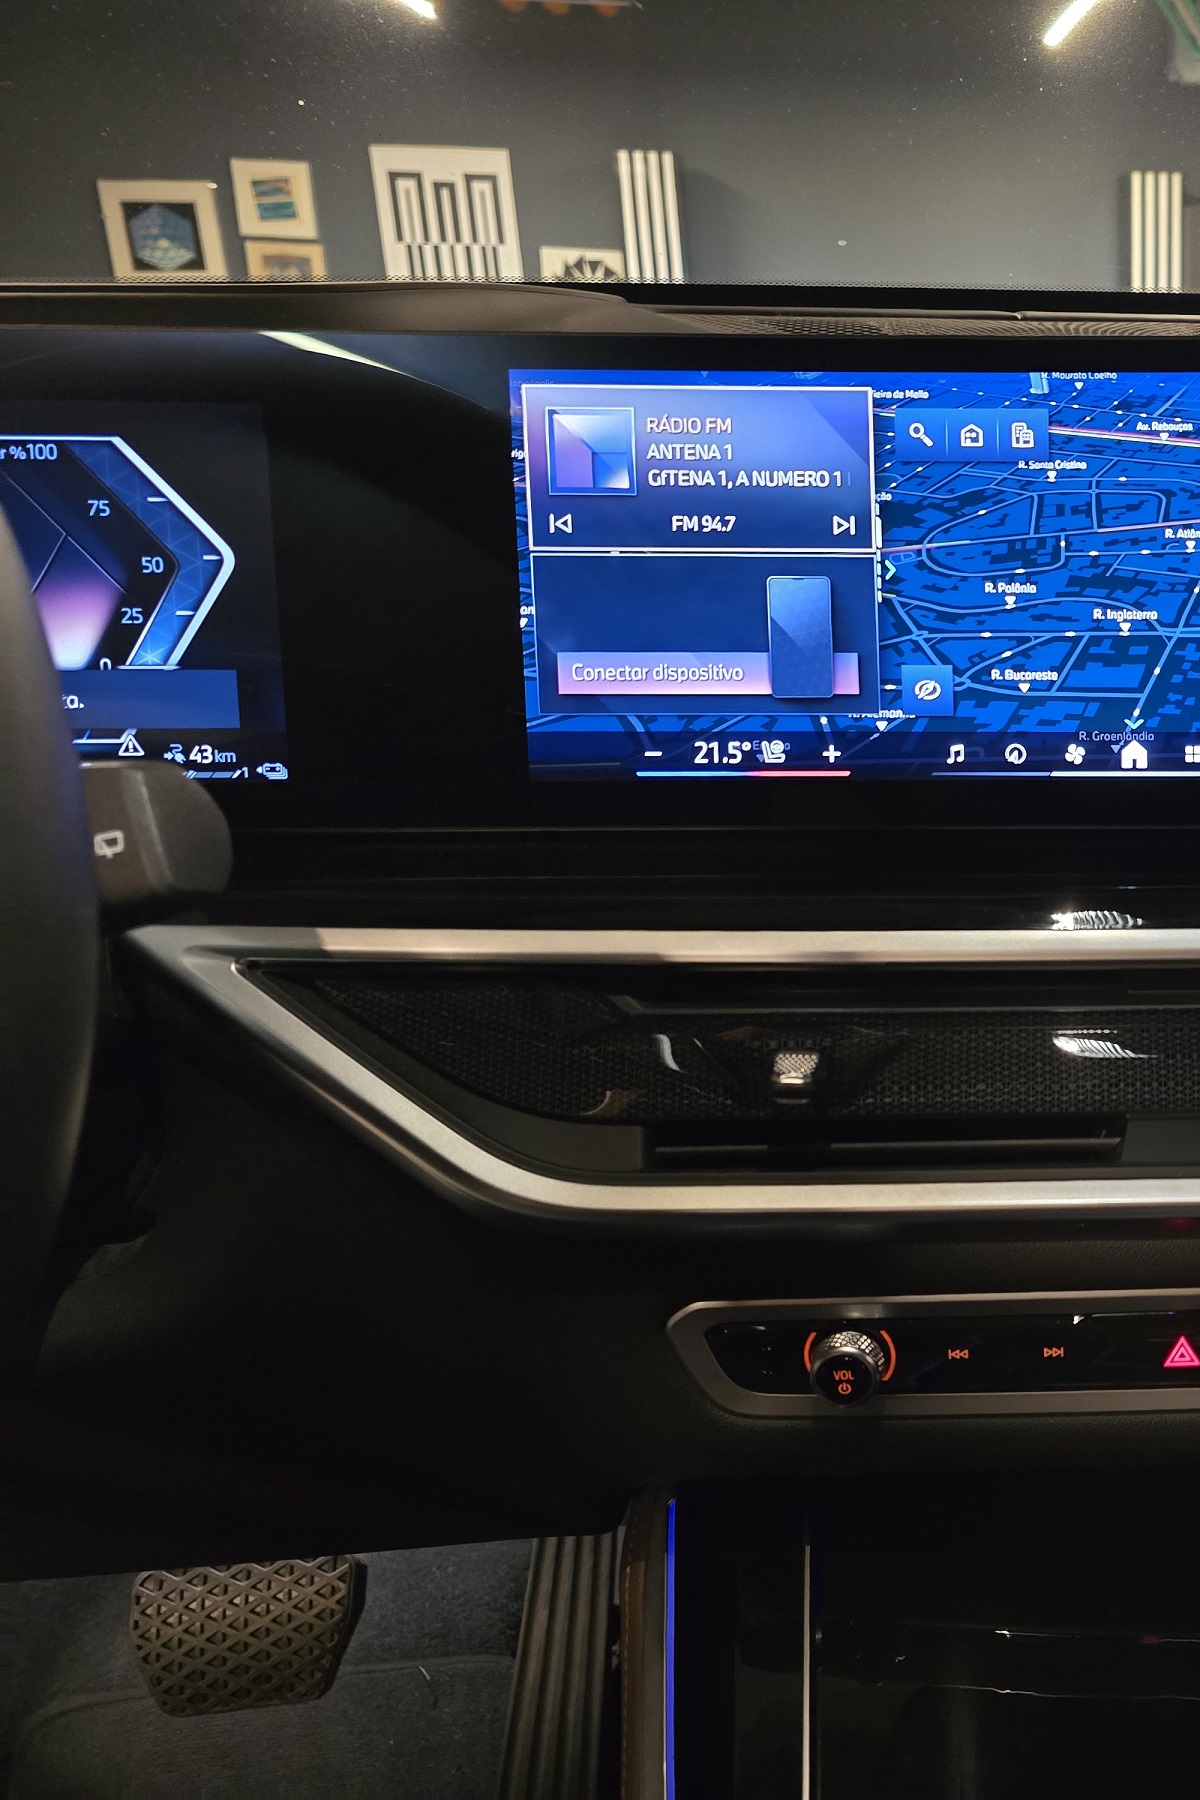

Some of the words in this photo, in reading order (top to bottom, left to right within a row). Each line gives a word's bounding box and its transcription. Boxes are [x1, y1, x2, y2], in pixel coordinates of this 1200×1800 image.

[646, 413, 702, 434] RÁDIO
[705, 417, 732, 434] FM
[1136, 421, 1151, 431] Av.
[1151, 421, 1194, 433] Rebouças
[646, 443, 722, 460] ANTENA
[723, 443, 733, 460] 1
[1018, 460, 1028, 469] R.
[717, 469, 733, 489] 1,
[735, 469, 750, 487] A
[752, 469, 830, 487] NUMERO
[832, 470, 841, 487] 1
[87, 499, 110, 517] 75
[671, 515, 699, 532] FM
[701, 515, 737, 532] 94.7
[1164, 528, 1176, 539] R.
[141, 556, 164, 574] 50
[984, 582, 996, 594] R.
[997, 581, 1037, 594] Polônia
[120, 607, 143, 624] 25
[1093, 608, 1105, 620] R.
[1106, 608, 1158, 622] Inglaterra
[571, 663, 650, 682] Conectar
[652, 663, 744, 683] dispositivo
[990, 669, 1003, 682] R.
[1004, 669, 1059, 682] Bucareste
[1078, 730, 1090, 741] R.
[1092, 729, 1155, 742] Groenlândia
[693, 741, 752, 764] 21.5°
[832, 1370, 855, 1381] VOL
